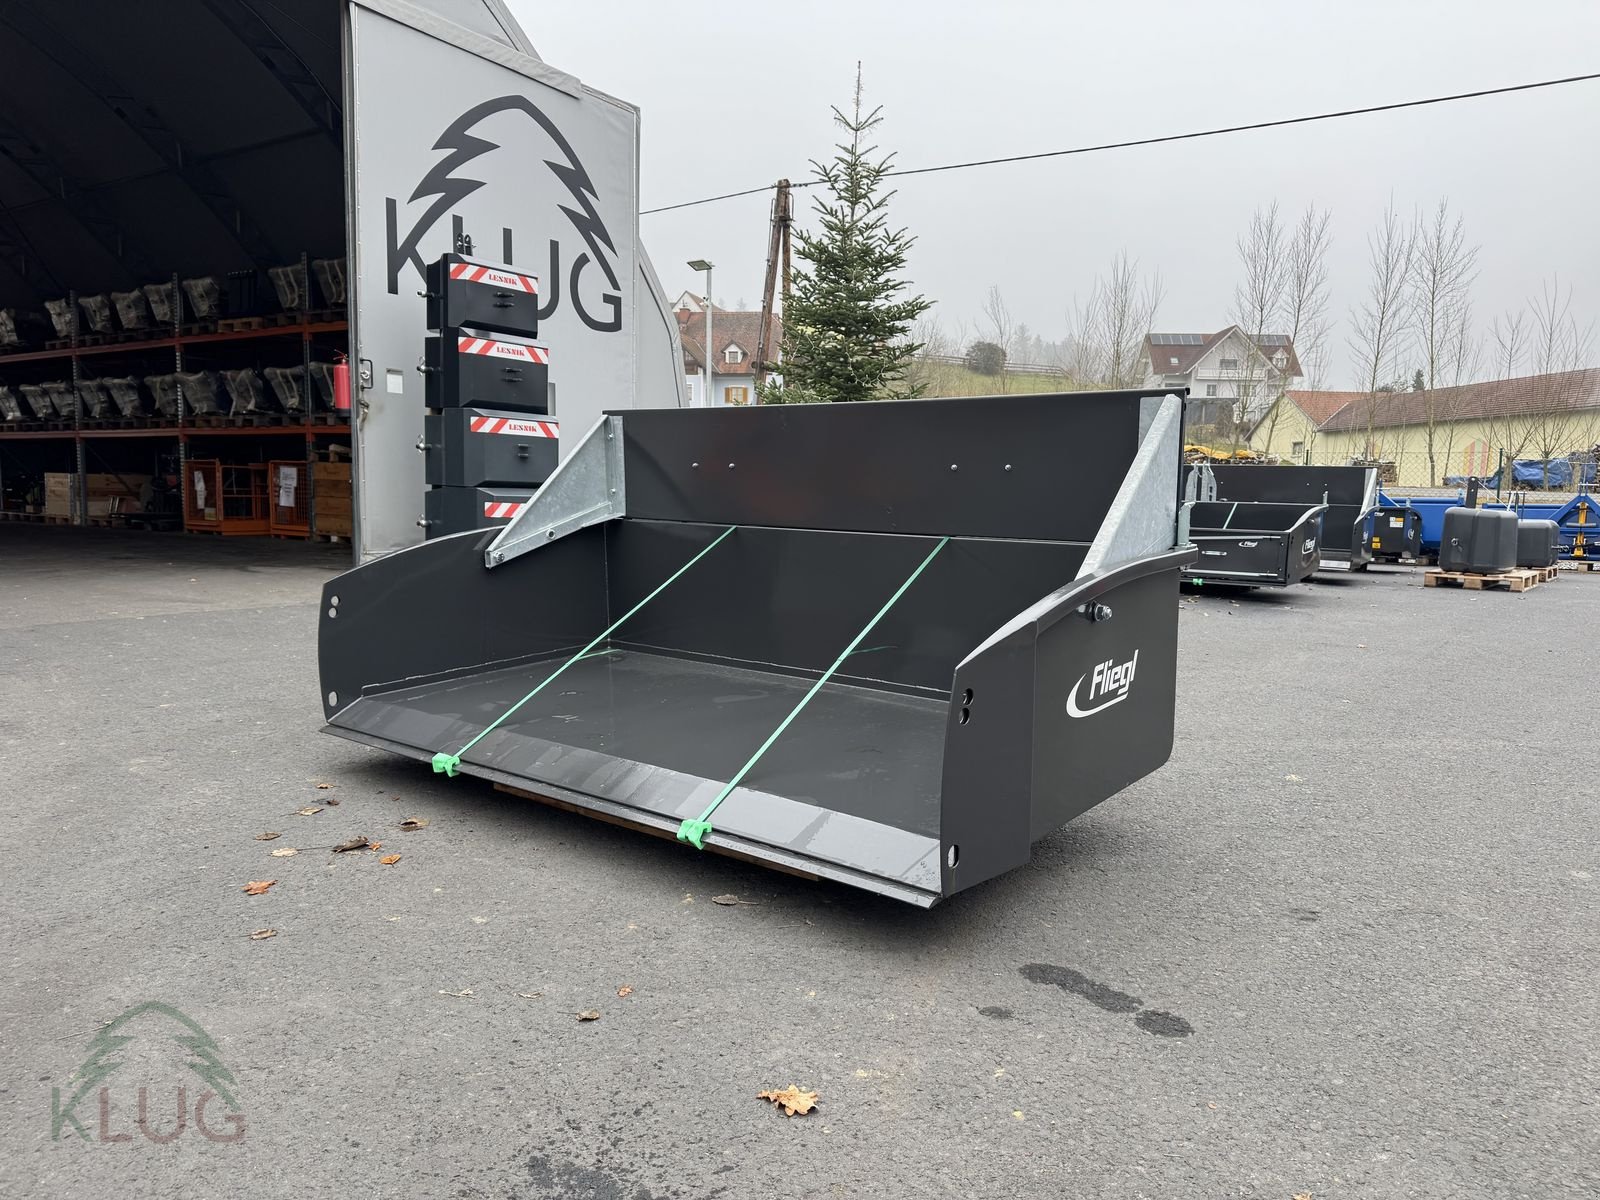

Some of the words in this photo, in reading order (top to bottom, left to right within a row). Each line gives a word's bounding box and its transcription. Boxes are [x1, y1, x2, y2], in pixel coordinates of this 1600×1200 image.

[488, 273, 518, 286] LESNIK
[496, 346, 525, 357] LESNIK
[508, 423, 537, 433] LESNIK
[1089, 648, 1139, 701] Fliegl
